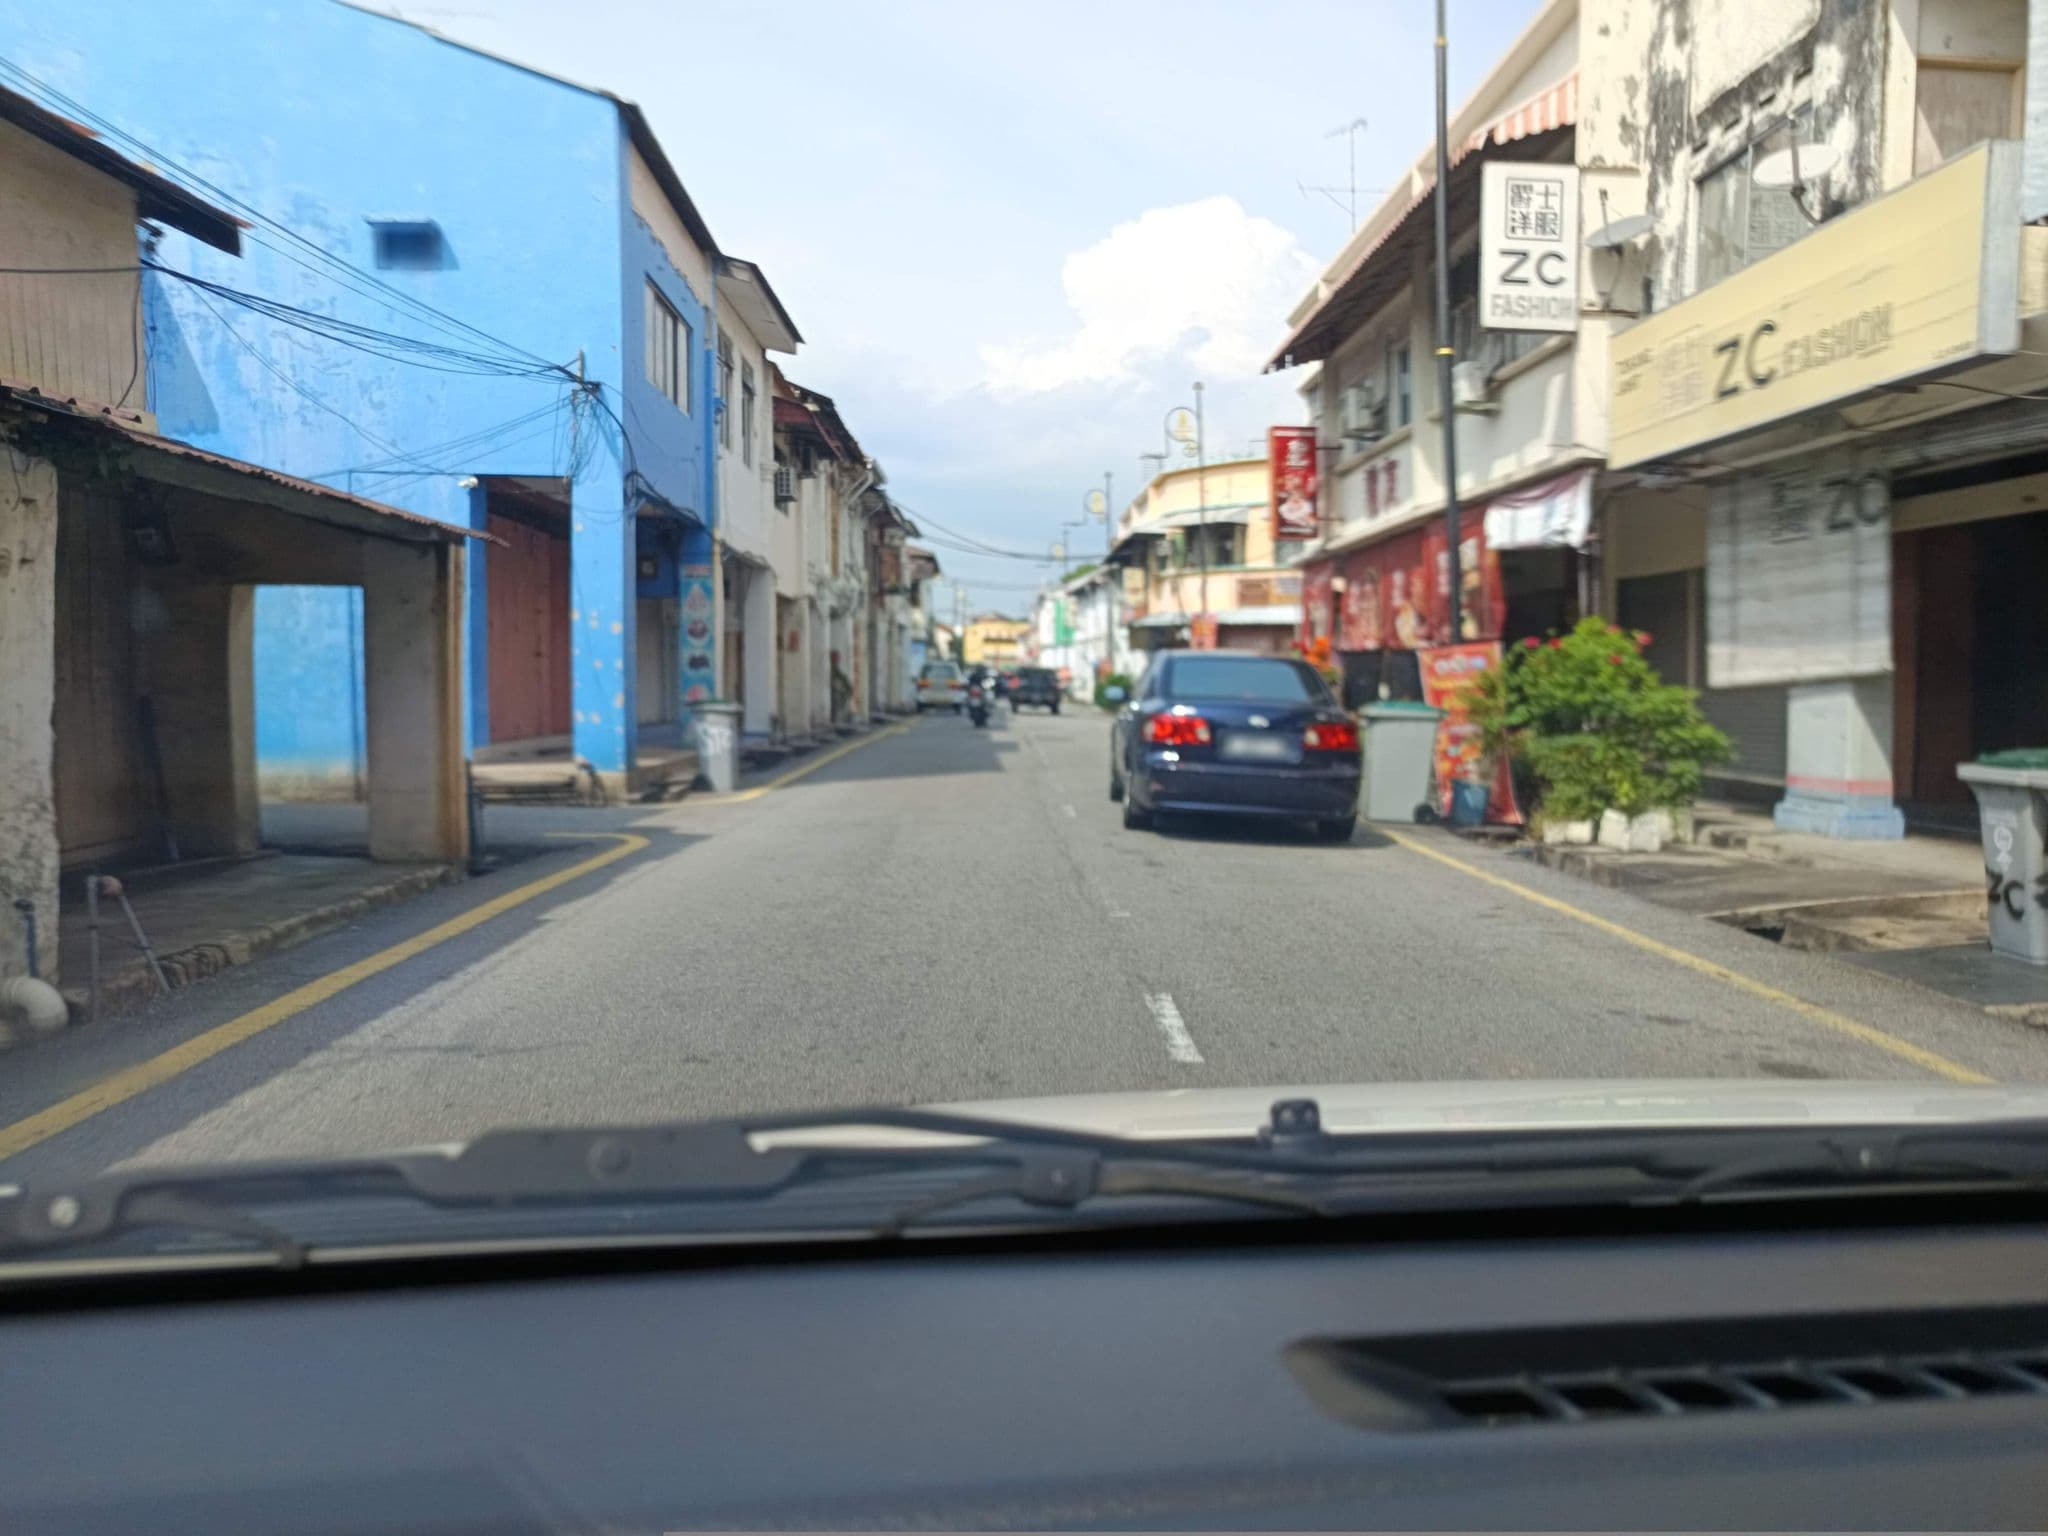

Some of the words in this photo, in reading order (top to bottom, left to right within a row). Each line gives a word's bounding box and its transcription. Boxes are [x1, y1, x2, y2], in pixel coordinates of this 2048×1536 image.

[1500, 249, 1566, 286] ZC
[1491, 293, 1574, 319] FASHION
[1713, 321, 1776, 398] ZC
